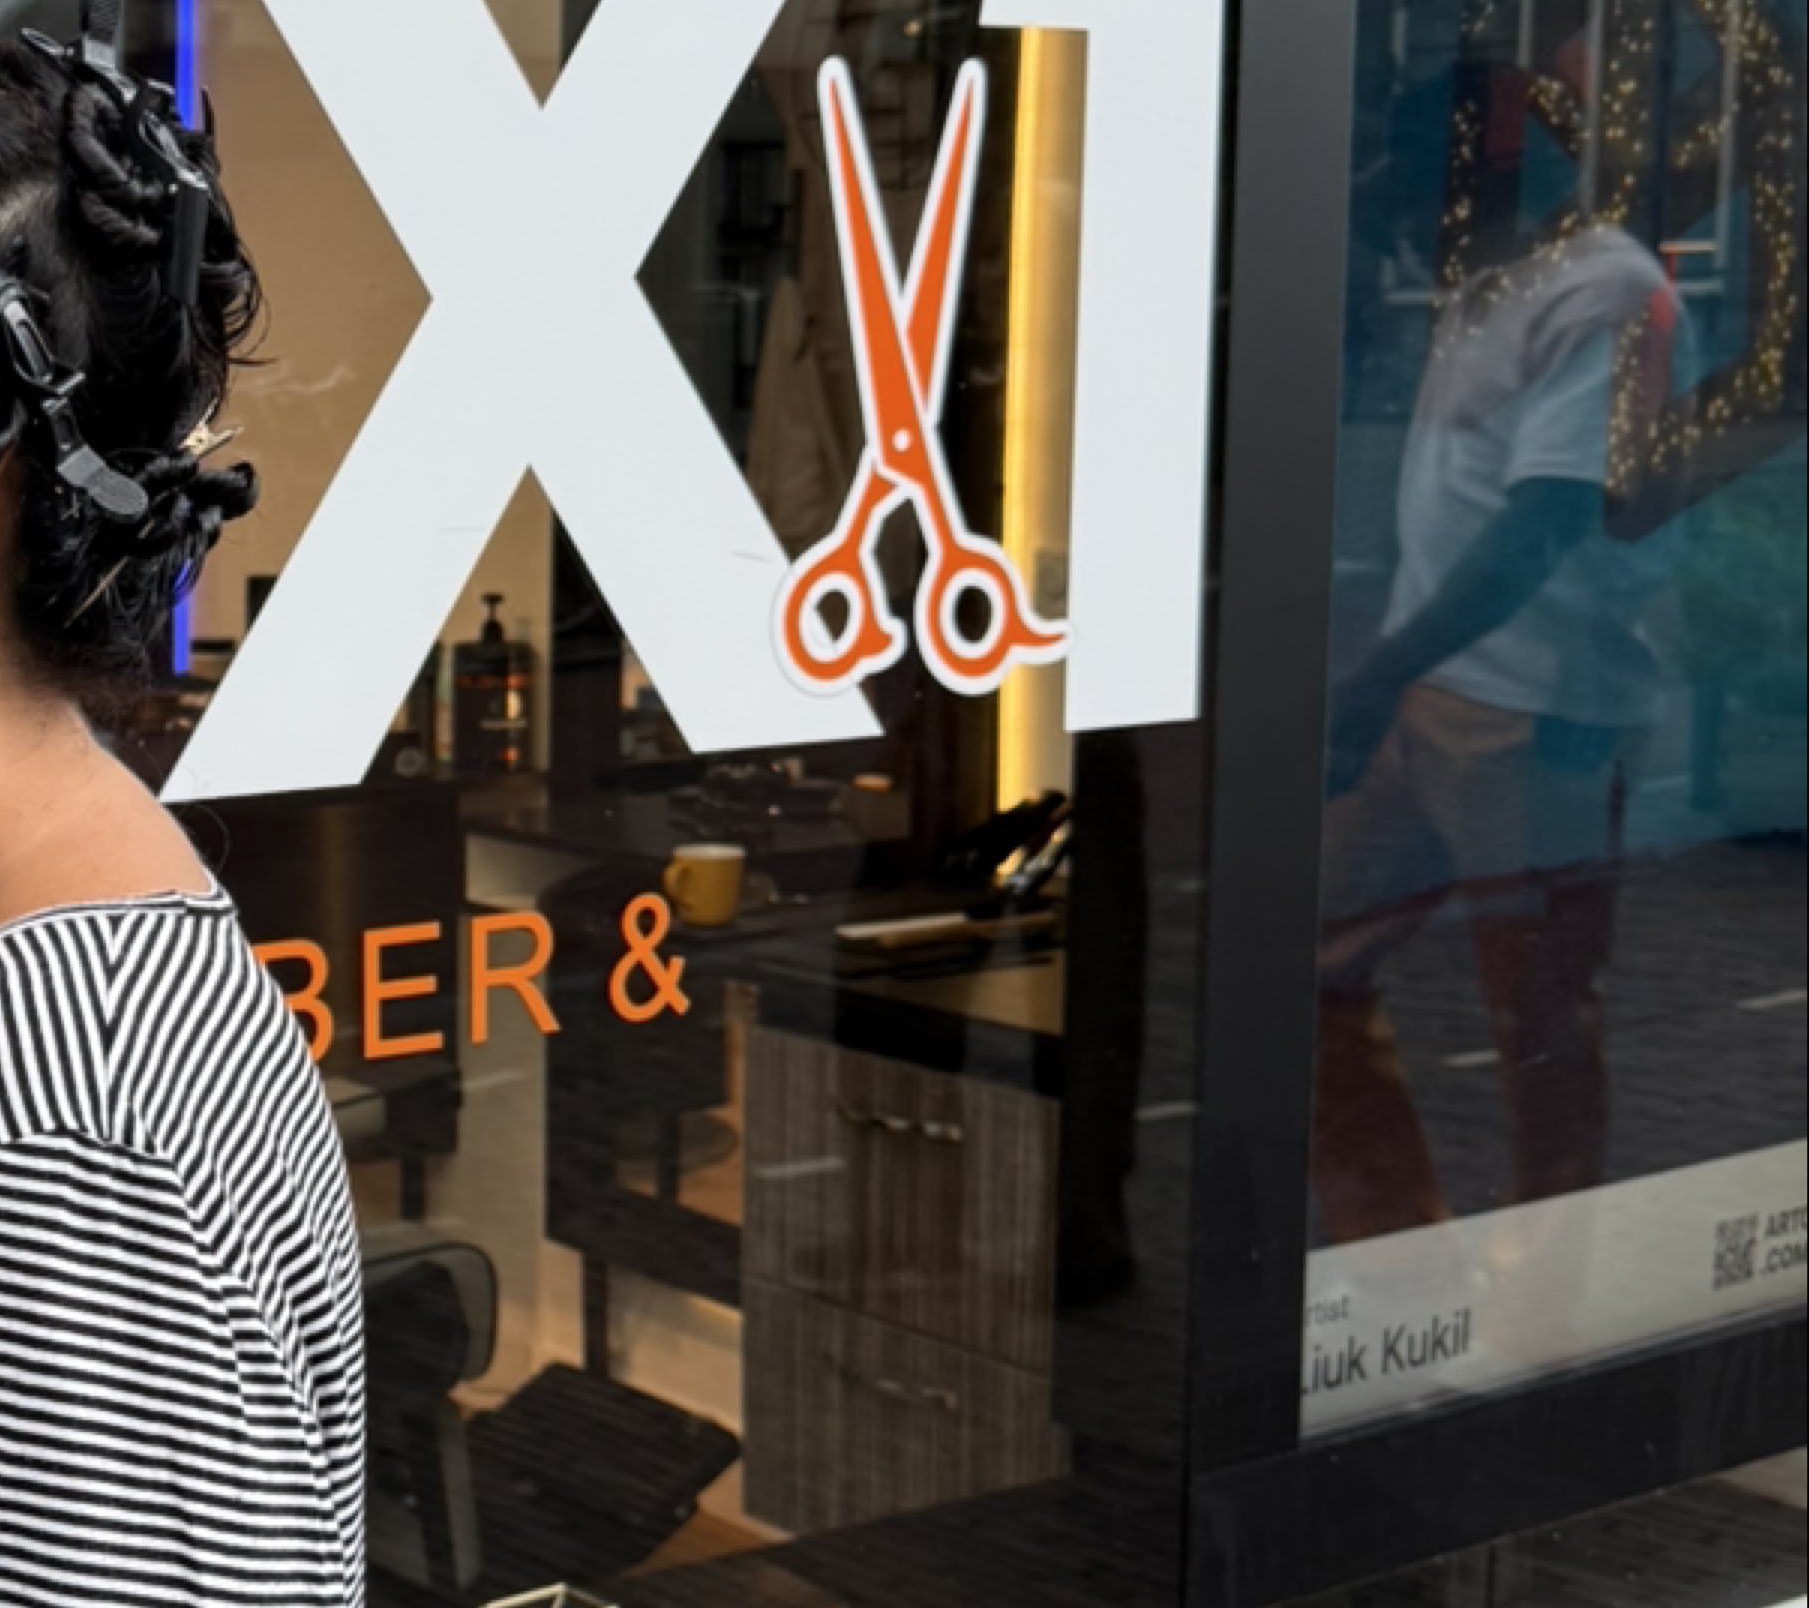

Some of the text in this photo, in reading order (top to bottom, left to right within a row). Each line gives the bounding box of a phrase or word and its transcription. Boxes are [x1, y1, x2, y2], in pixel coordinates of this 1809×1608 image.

[251, 891, 692, 1062] BER &
[1300, 1305, 1472, 1396] iuk Kukil
